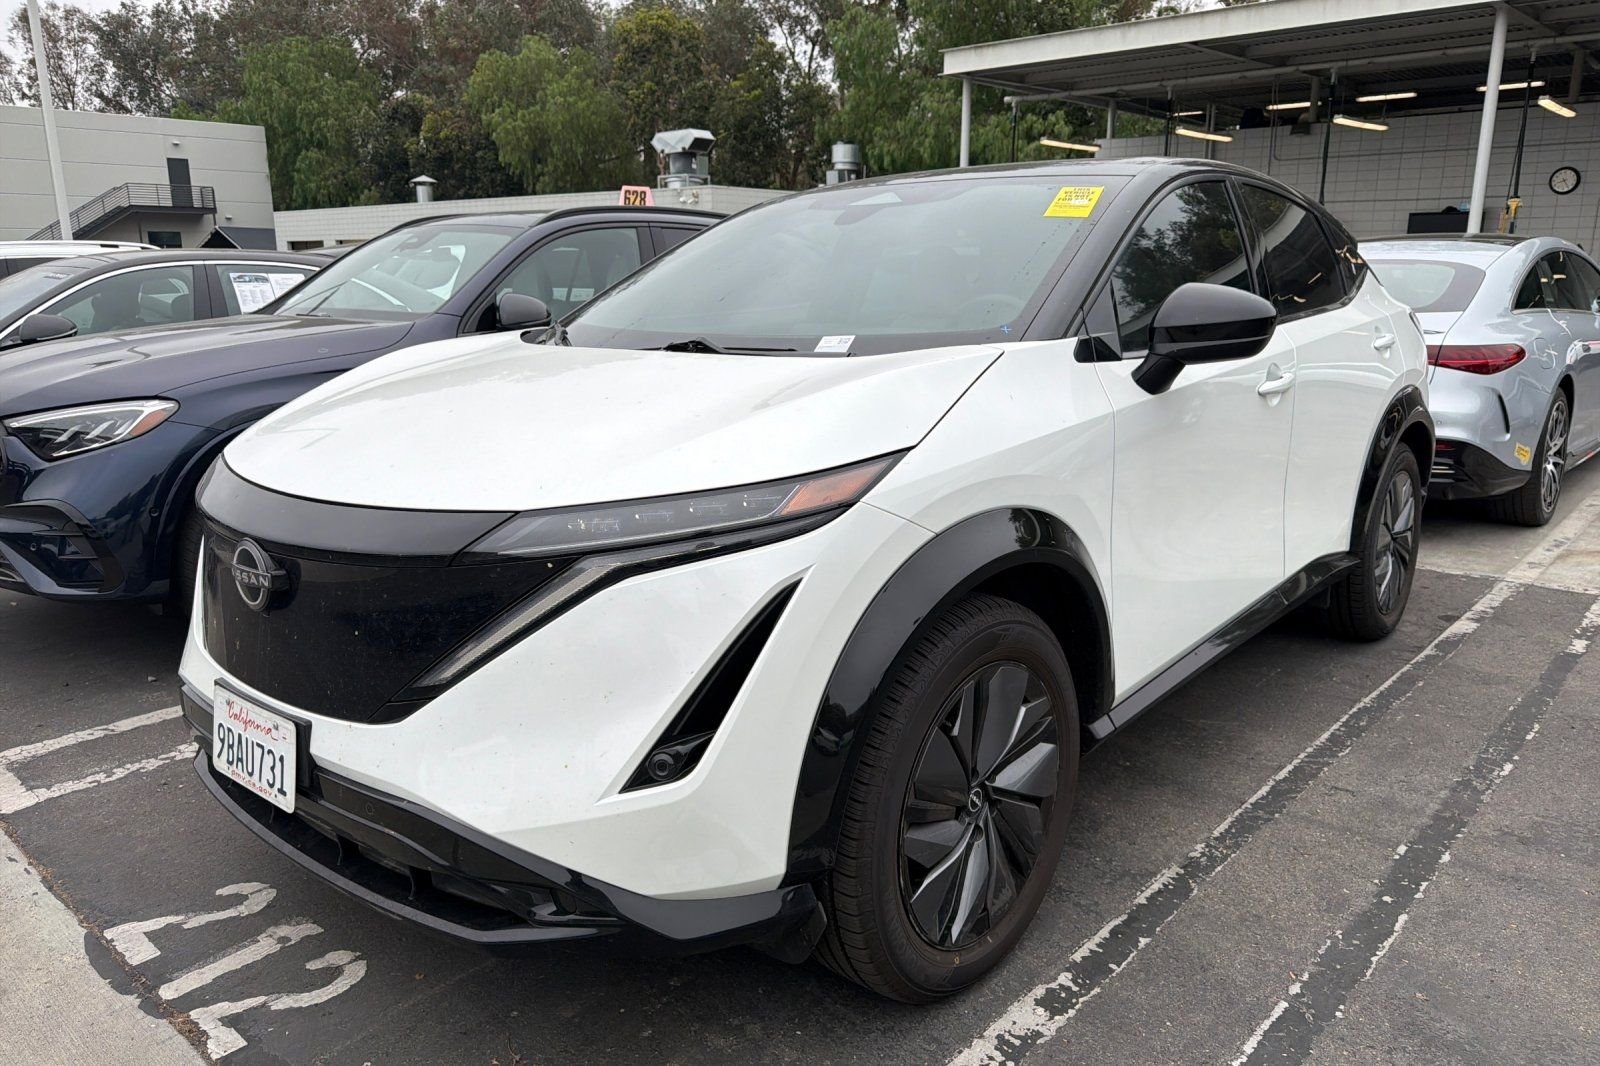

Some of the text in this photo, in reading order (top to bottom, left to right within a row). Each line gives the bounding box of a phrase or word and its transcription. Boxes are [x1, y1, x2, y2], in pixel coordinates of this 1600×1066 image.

[624, 190, 646, 205] 628
[227, 700, 279, 741] California
[217, 722, 287, 797] 9BAU731
[103, 881, 368, 1062] 212
